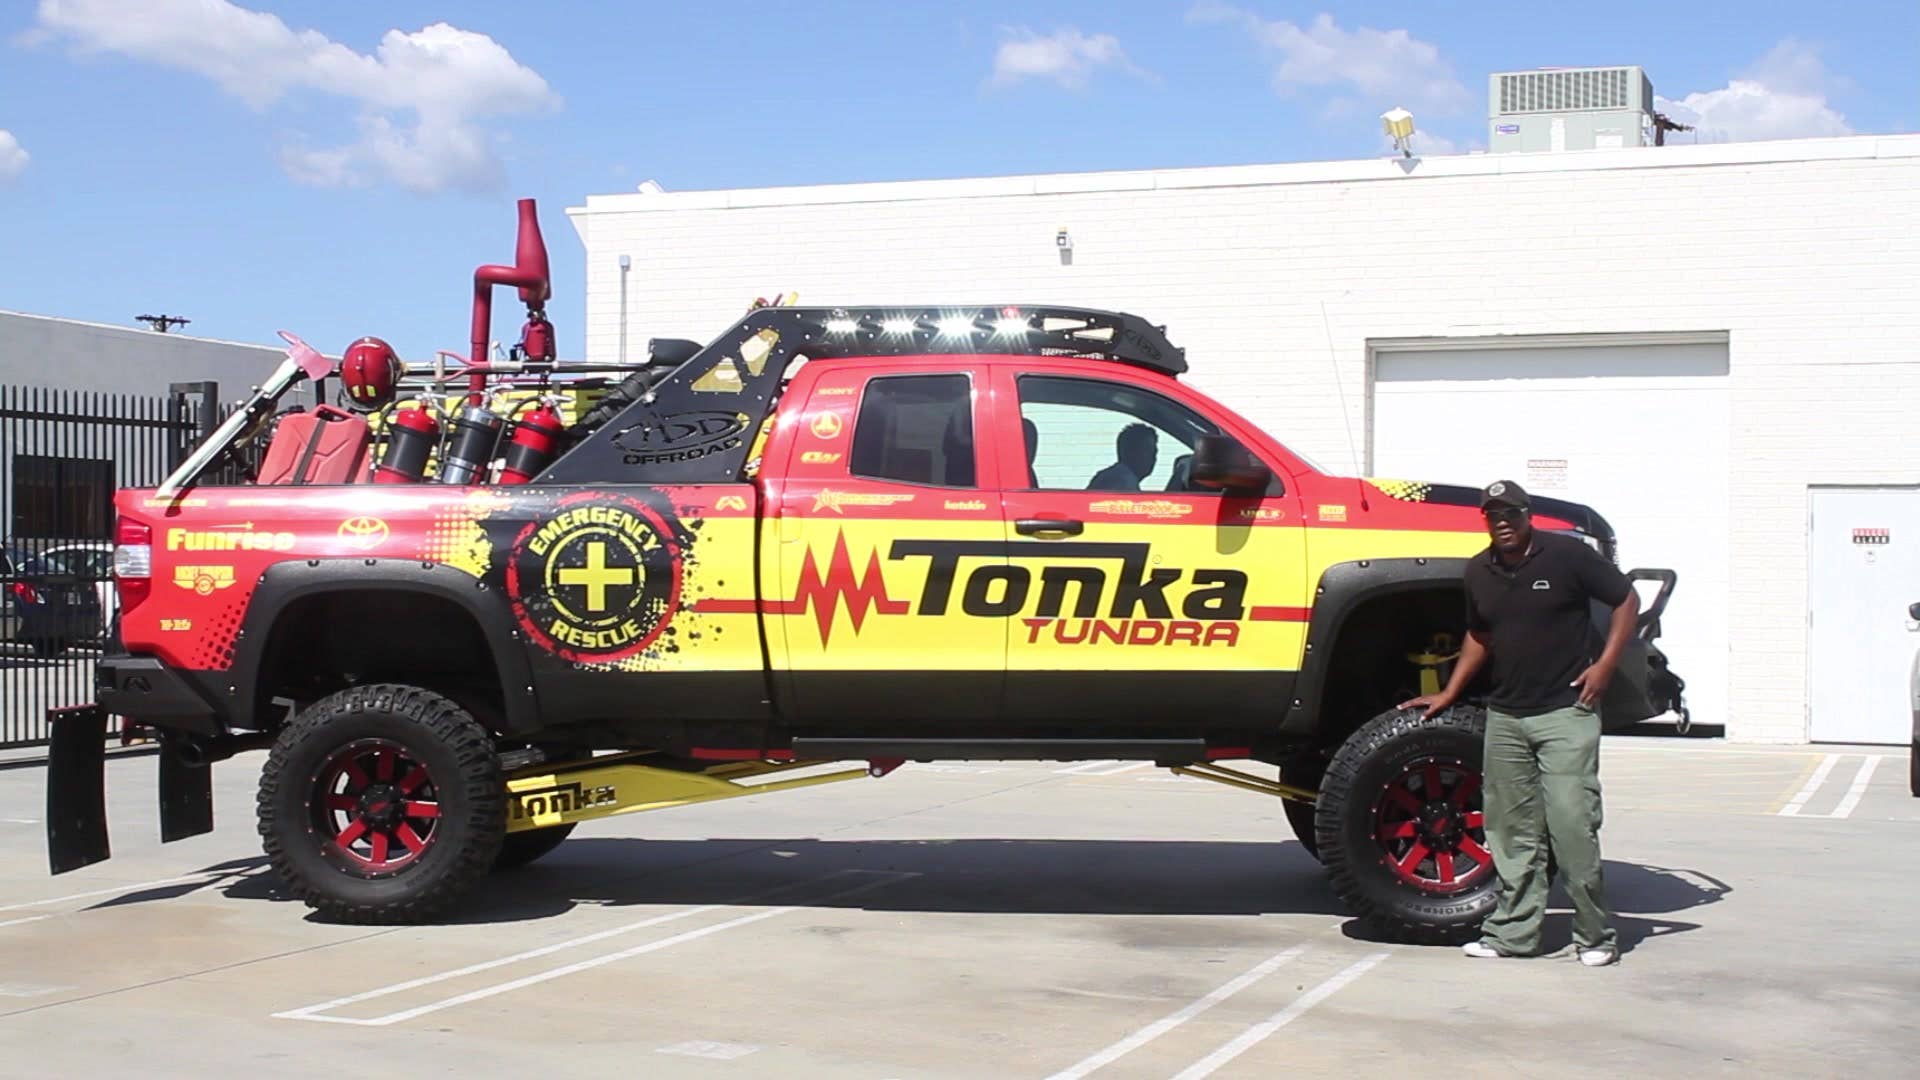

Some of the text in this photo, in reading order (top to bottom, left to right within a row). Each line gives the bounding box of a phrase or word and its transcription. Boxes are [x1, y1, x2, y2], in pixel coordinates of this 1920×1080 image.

[623, 437, 743, 465] OFFROAD
[166, 528, 296, 551] Funrise
[528, 507, 662, 556] EMERGENCY
[887, 539, 1249, 620] Tonka
[550, 618, 642, 649] RESCUE
[1022, 618, 1241, 647] TUNDRA
